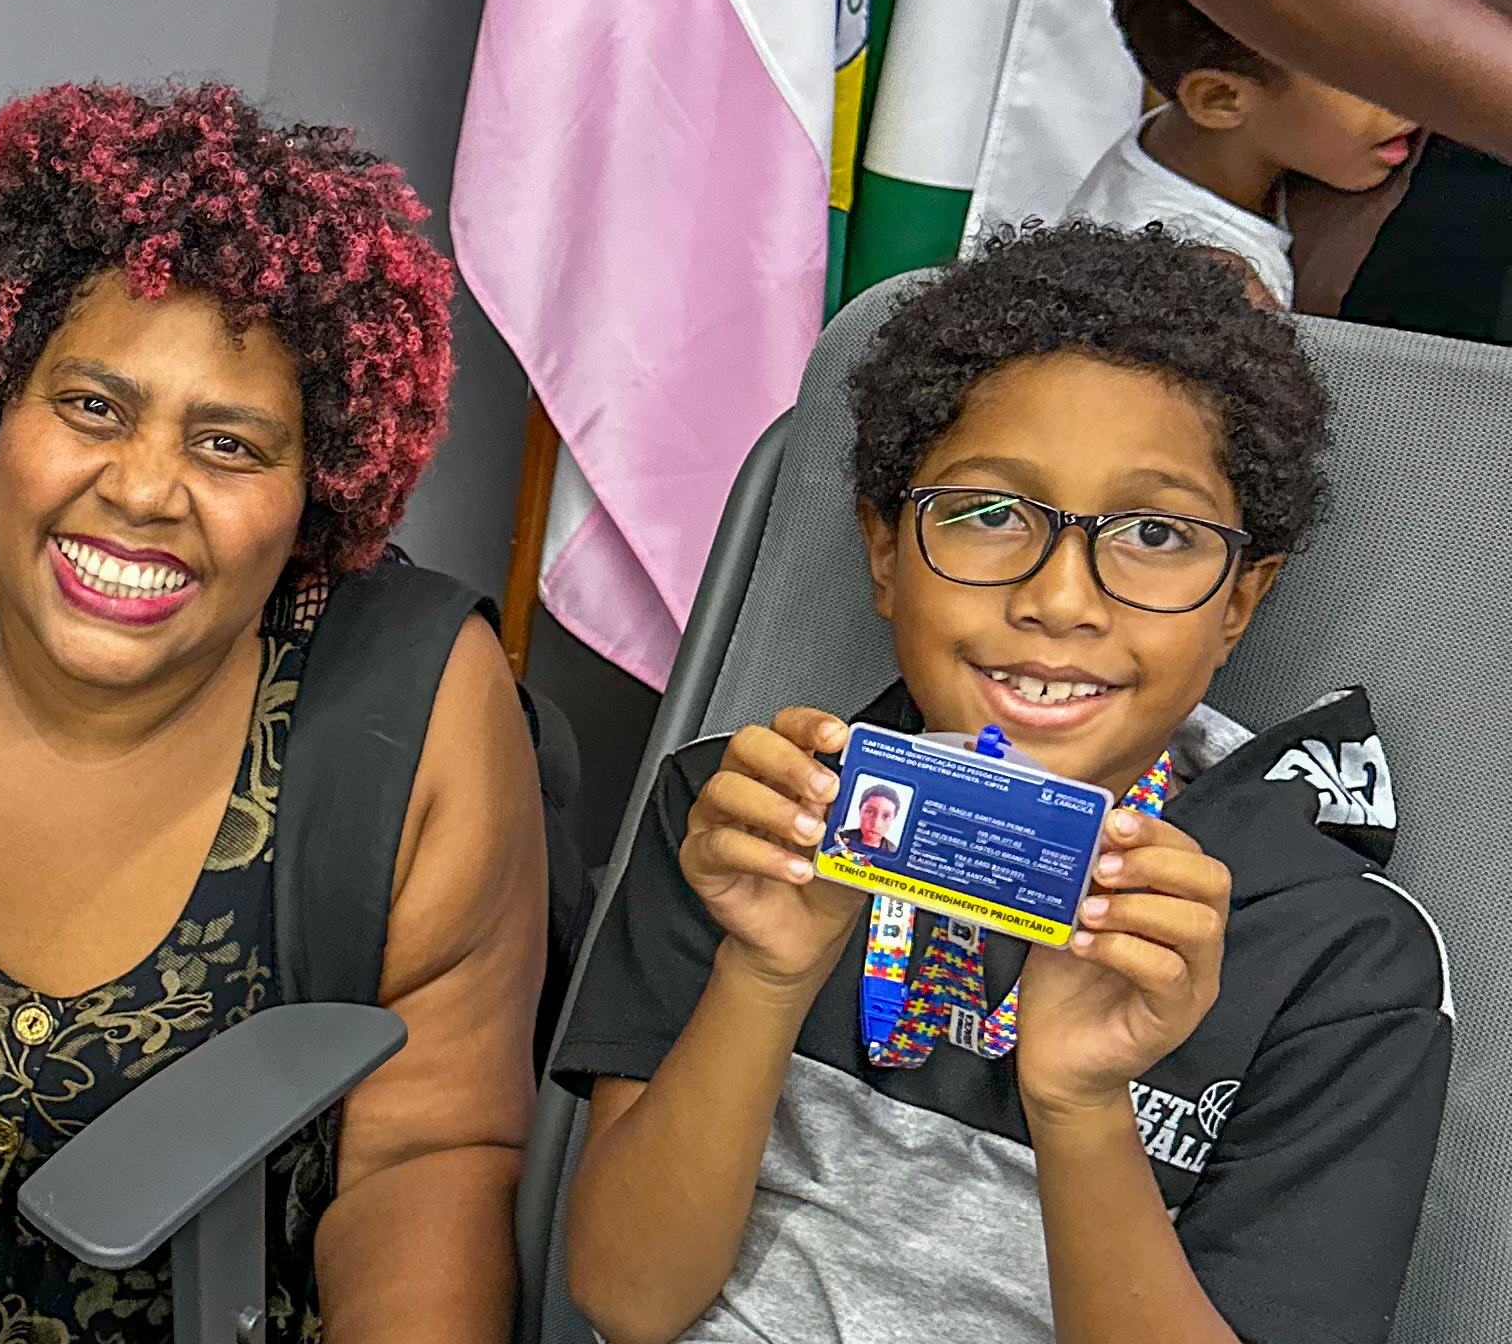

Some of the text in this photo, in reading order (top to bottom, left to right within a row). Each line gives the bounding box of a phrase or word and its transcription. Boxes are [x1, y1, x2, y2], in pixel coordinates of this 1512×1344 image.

[1053, 797, 1093, 815] CARIACICA
[833, 862, 867, 879] TENHO
[868, 872, 907, 891] DIREITO
[917, 887, 989, 915] ATENDIMENTO
[989, 906, 1055, 935] PRIORITÁRIO
